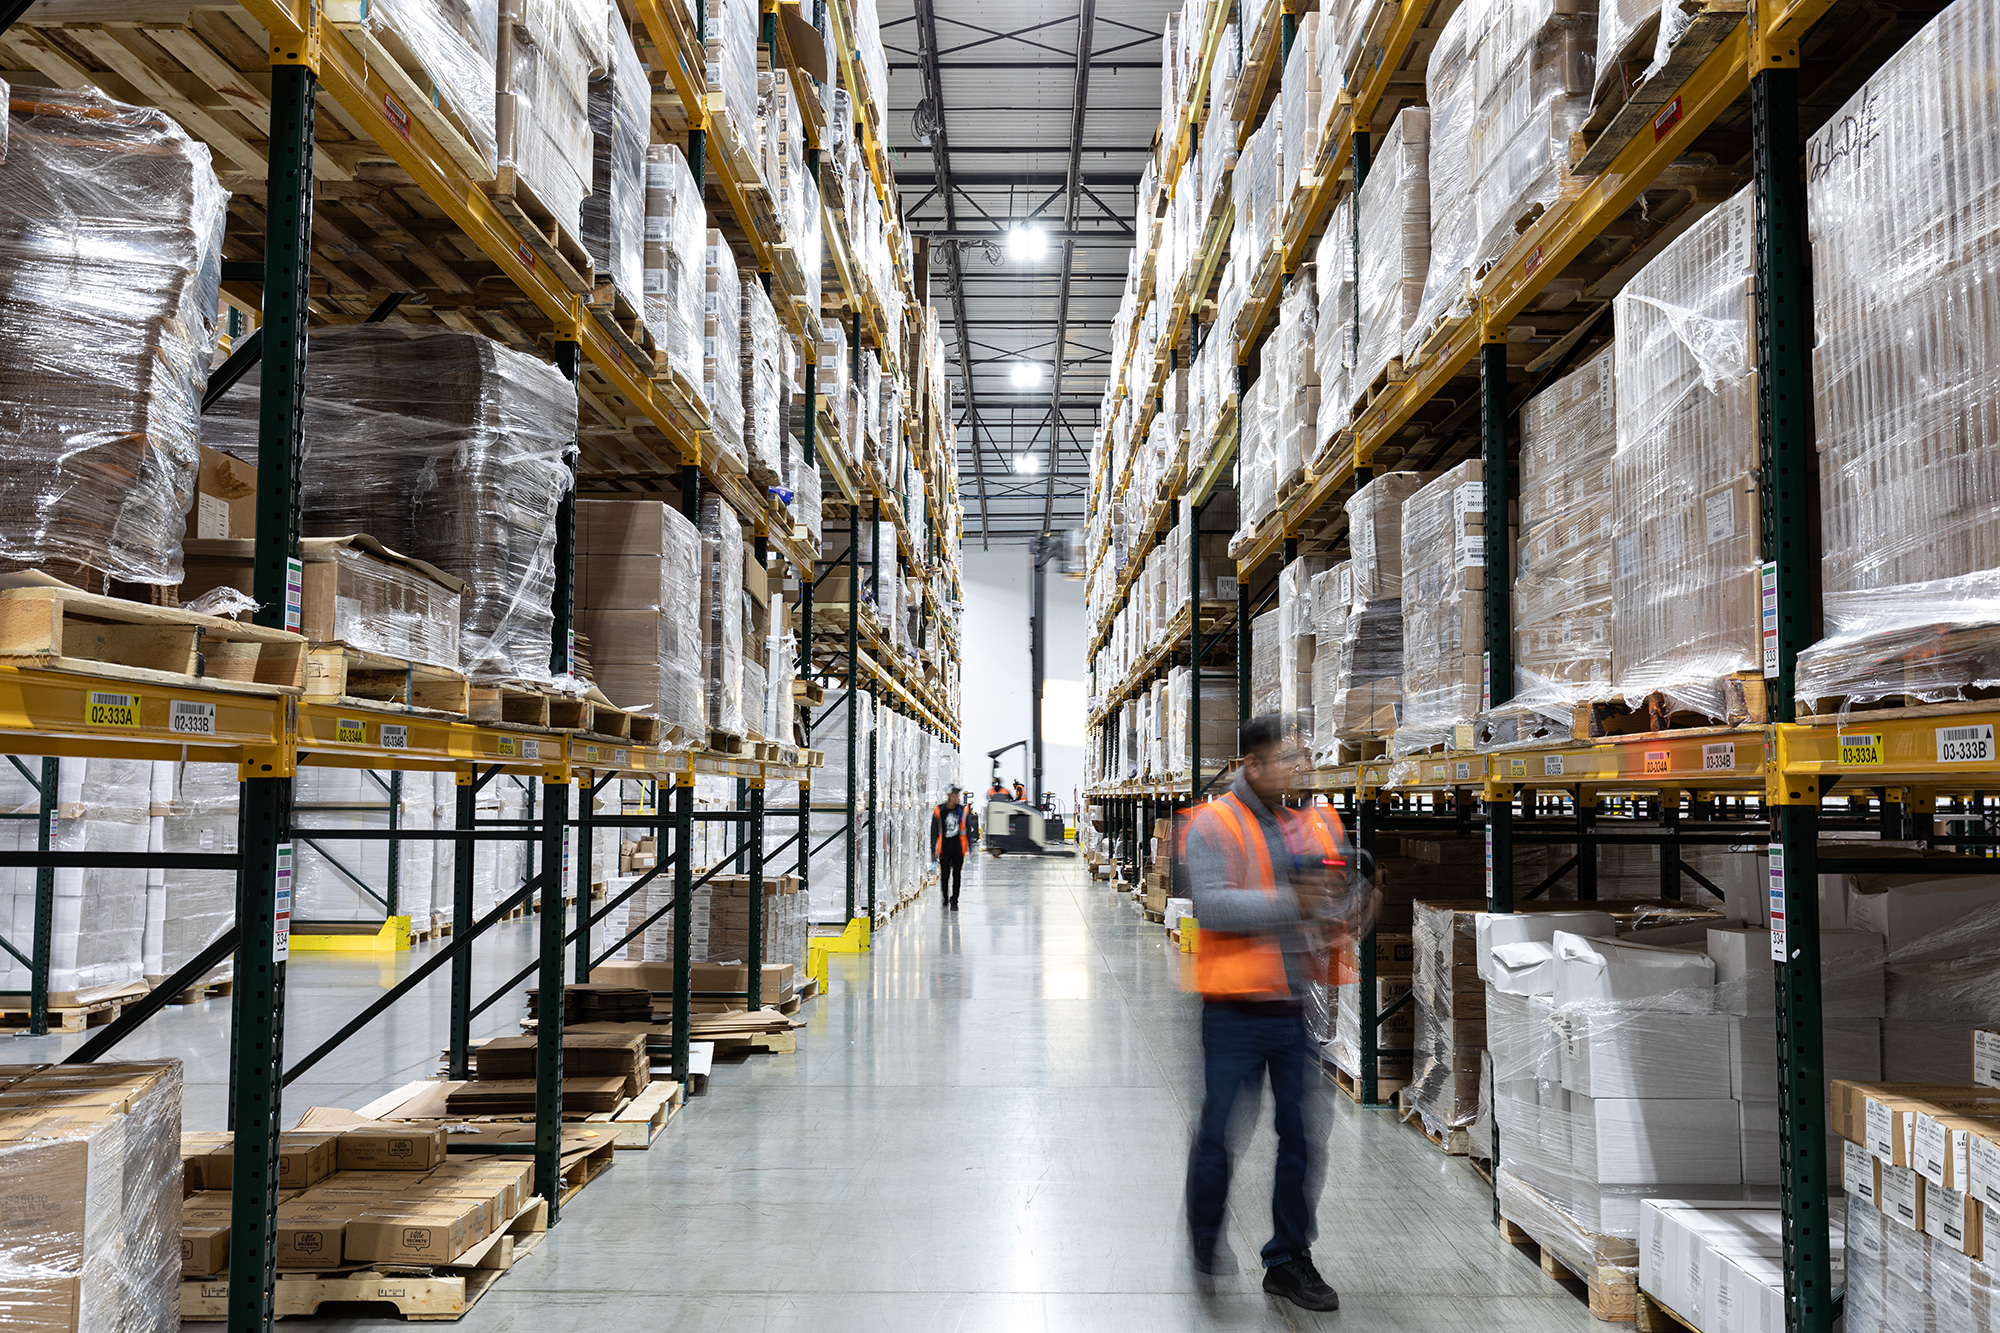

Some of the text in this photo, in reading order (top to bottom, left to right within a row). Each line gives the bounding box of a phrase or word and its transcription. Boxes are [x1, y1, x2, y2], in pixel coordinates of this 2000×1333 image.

[1765, 649, 1776, 662] 333
[92, 705, 133, 725] 02-333A
[174, 715, 209, 732] 02-333B
[340, 729, 363, 743] 02-334A
[383, 735, 404, 748] 02-334B
[1843, 748, 1878, 763] 03-333A
[1943, 741, 1987, 760] 03-333B
[1647, 761, 1668, 773] 03-334A
[1706, 755, 1731, 768] 03-334B
[276, 932, 287, 945] 334
[1773, 932, 1783, 945] 334
